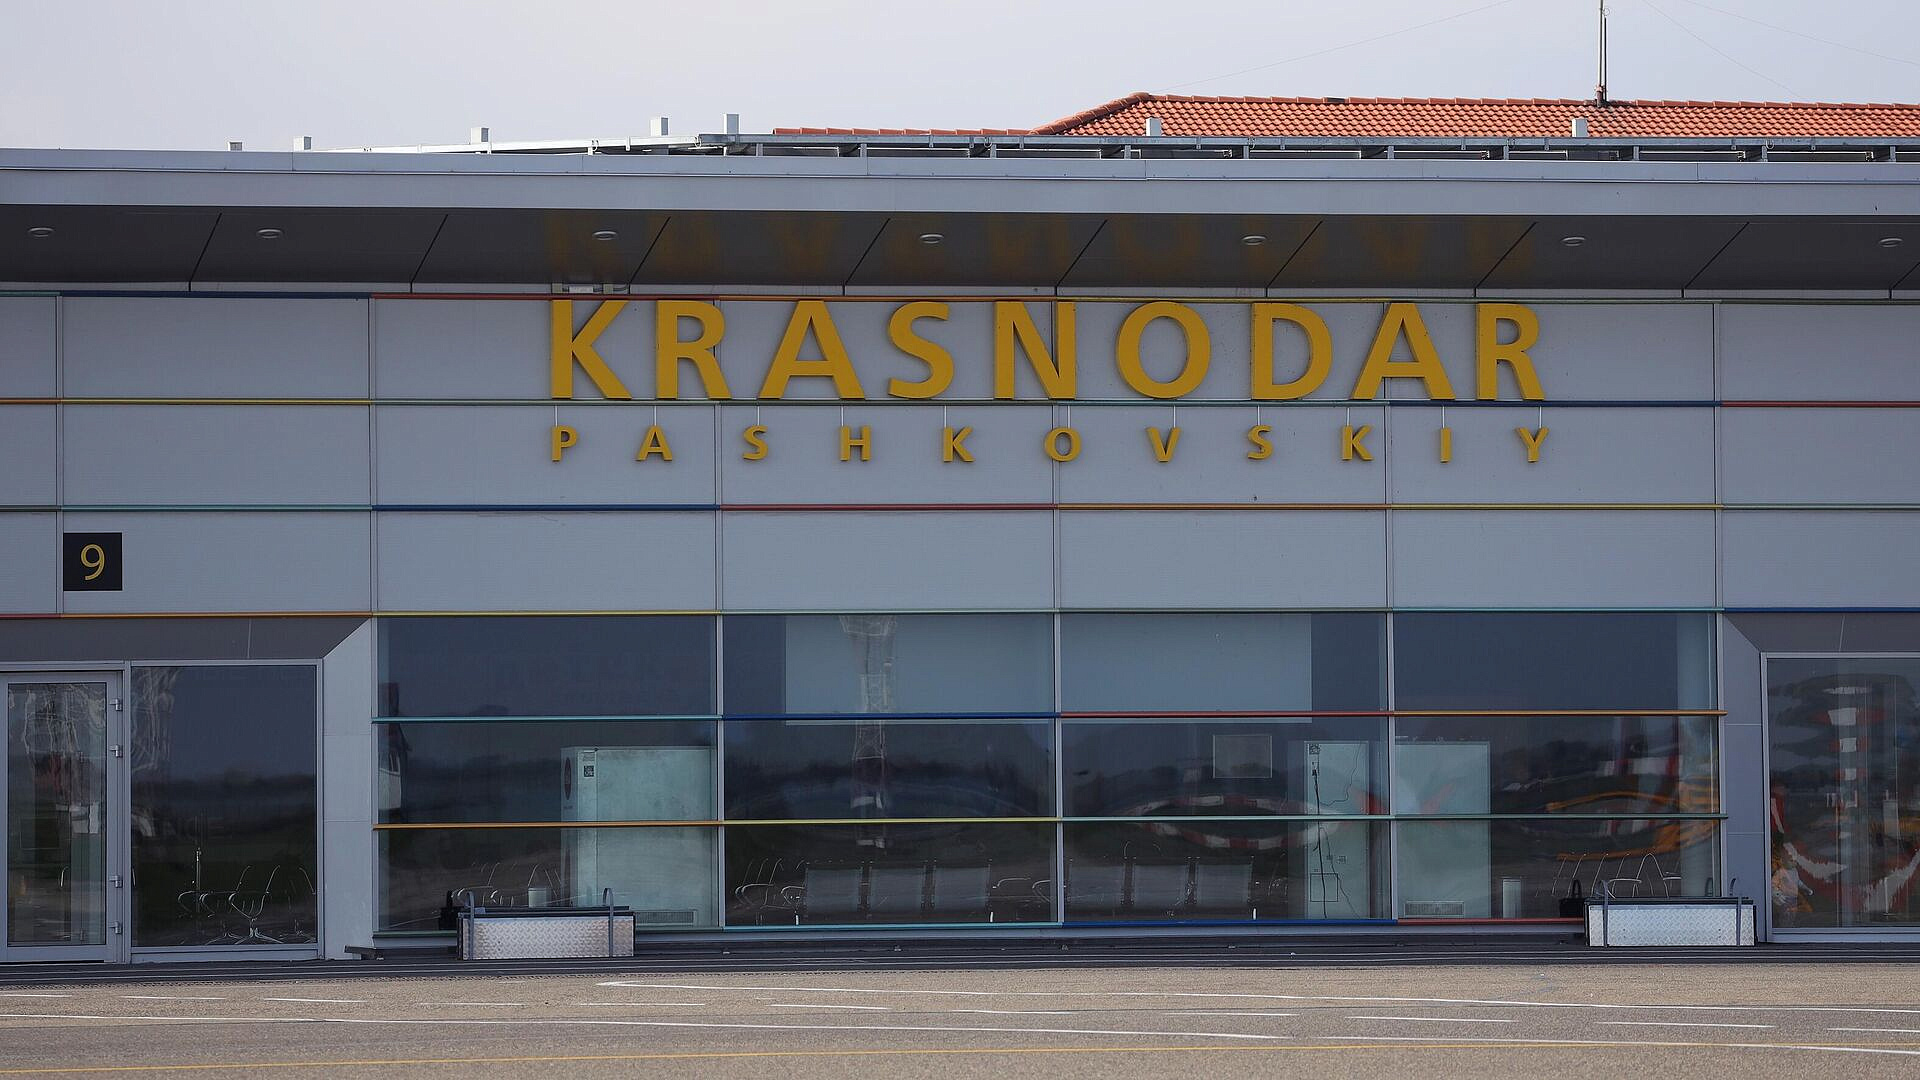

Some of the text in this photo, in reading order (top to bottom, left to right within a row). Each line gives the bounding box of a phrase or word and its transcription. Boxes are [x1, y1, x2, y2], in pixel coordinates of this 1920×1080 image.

[550, 299, 1545, 401] KRASNODAR
[551, 425, 1549, 463] PASHKOVSKIY
[80, 543, 105, 581] 9
